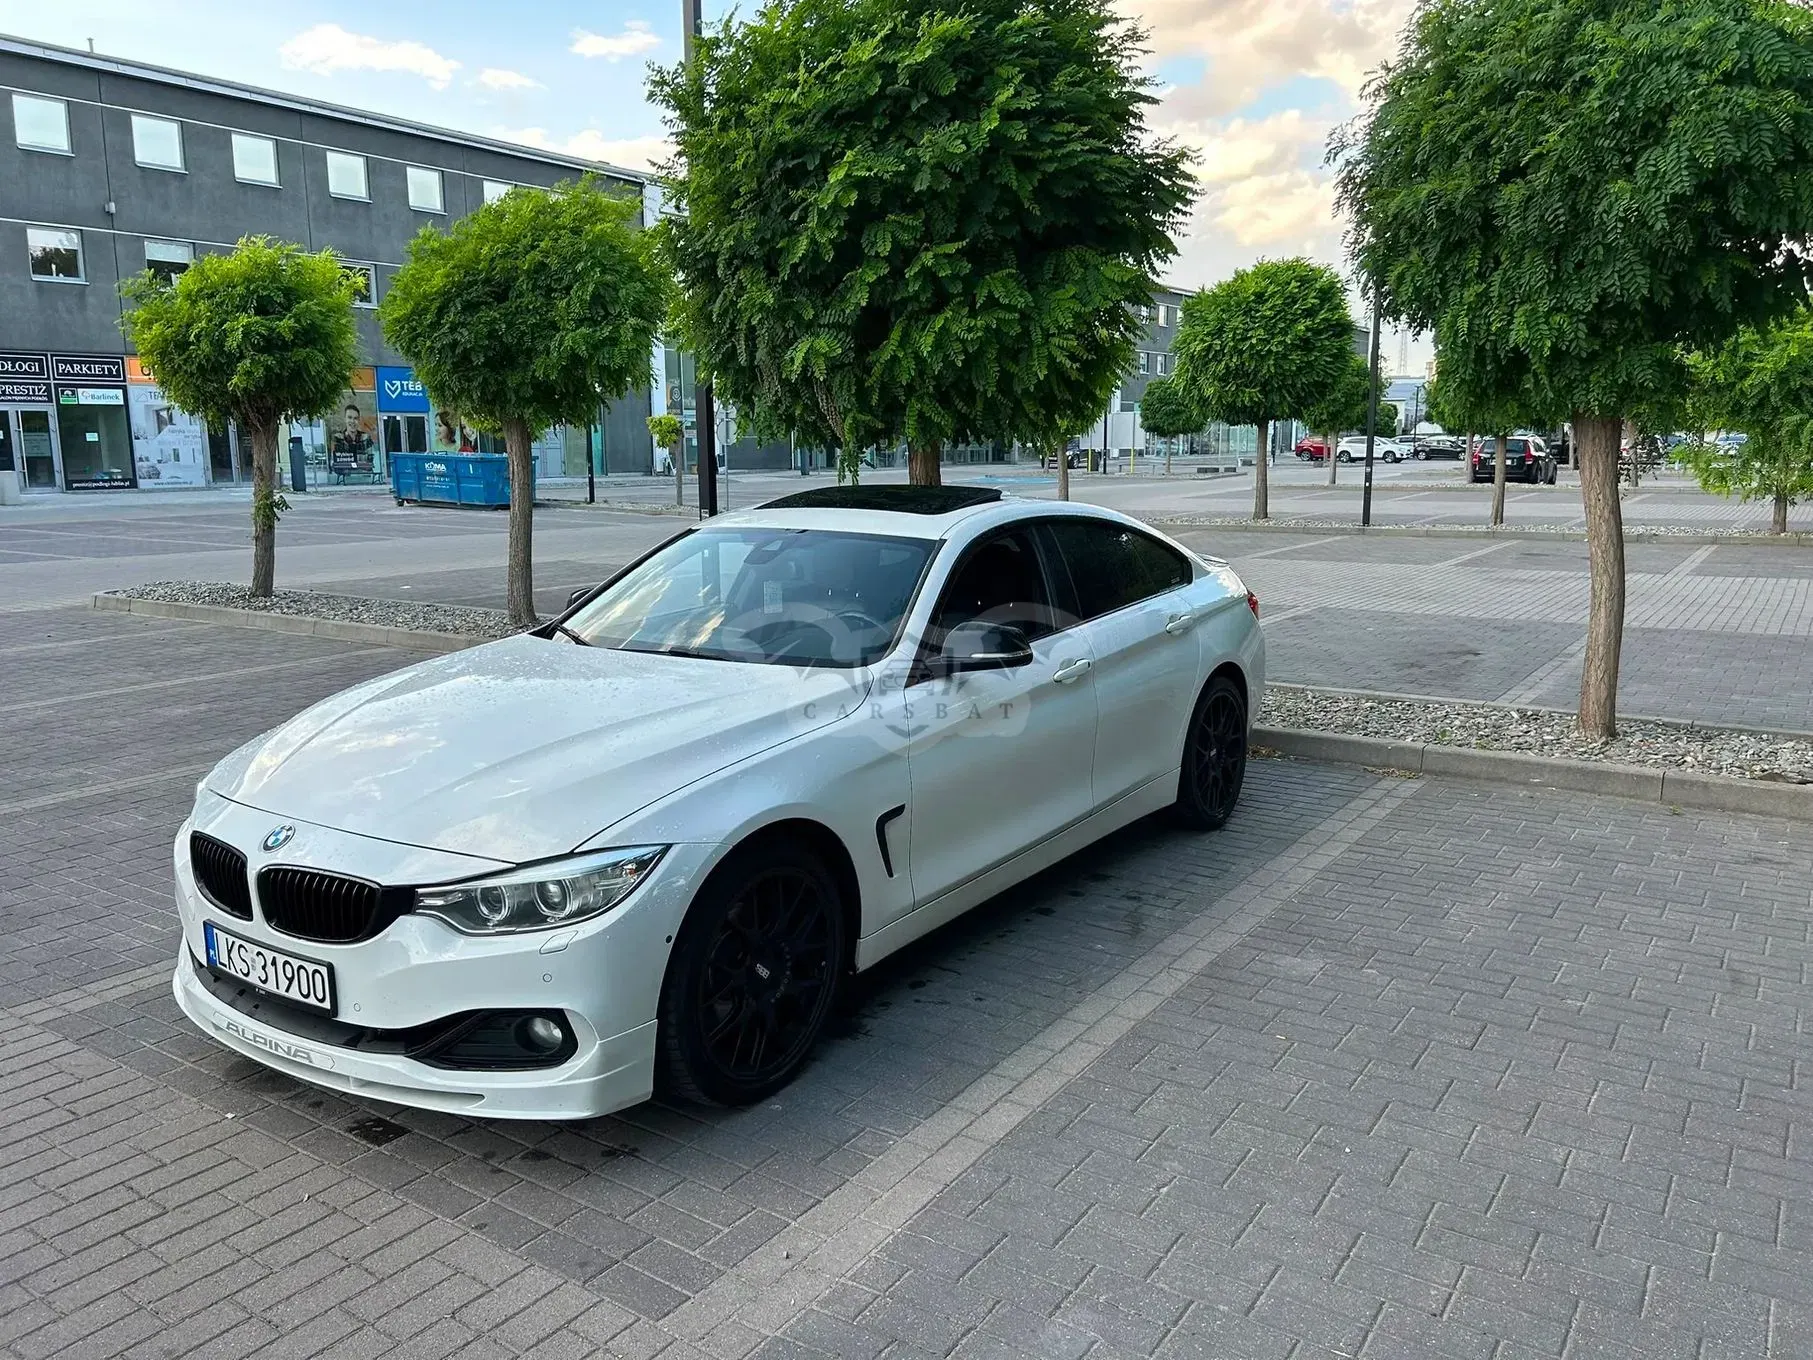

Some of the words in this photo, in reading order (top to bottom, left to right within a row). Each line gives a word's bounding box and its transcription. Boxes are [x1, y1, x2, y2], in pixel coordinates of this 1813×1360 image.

[0, 361, 40, 372] DŁOGI
[57, 363, 119, 375] PARKIETY
[0, 383, 48, 396] PRESTIŻ
[401, 380, 423, 391] TEB
[90, 393, 121, 401] Barlinek
[209, 950, 217, 960] PL
[215, 932, 251, 978] LKS
[255, 950, 327, 1004] 31900
[225, 1021, 315, 1064] ALPINA
